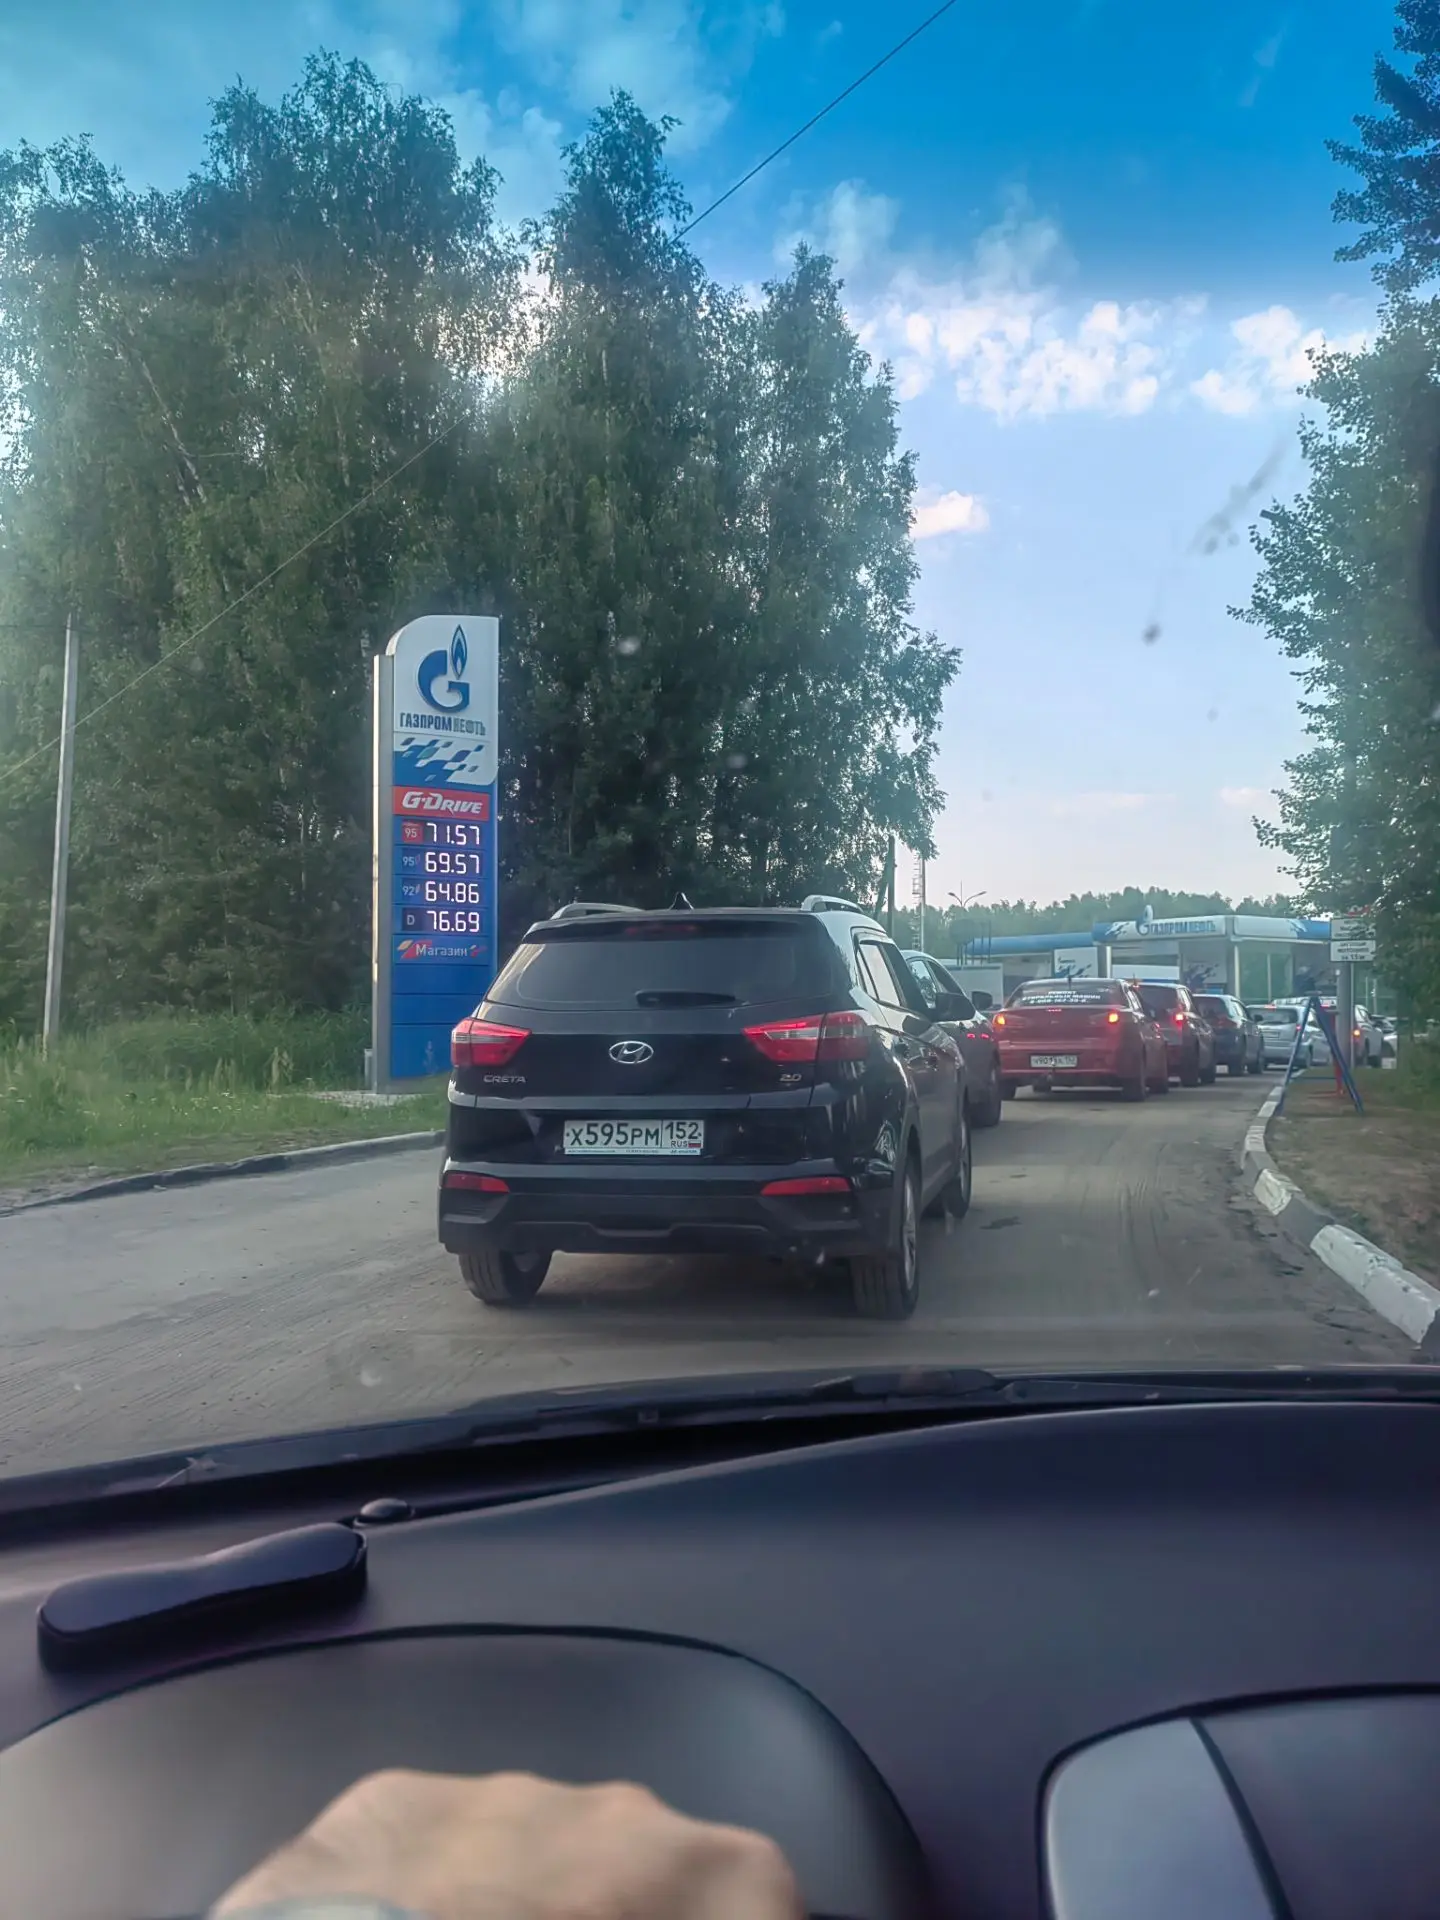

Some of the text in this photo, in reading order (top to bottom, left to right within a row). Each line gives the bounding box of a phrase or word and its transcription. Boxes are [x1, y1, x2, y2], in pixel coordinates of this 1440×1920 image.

[400, 712, 486, 736] ГАЗПРОМНЕФТЬ
[404, 823, 480, 845] 95 71.57
[402, 852, 480, 874] 95 69.57
[402, 881, 480, 904] 92 64.86
[406, 911, 480, 933] D 76.69
[415, 943, 467, 957] Магазин
[483, 1074, 527, 1083] CRETA
[665, 1121, 699, 1140] 152
